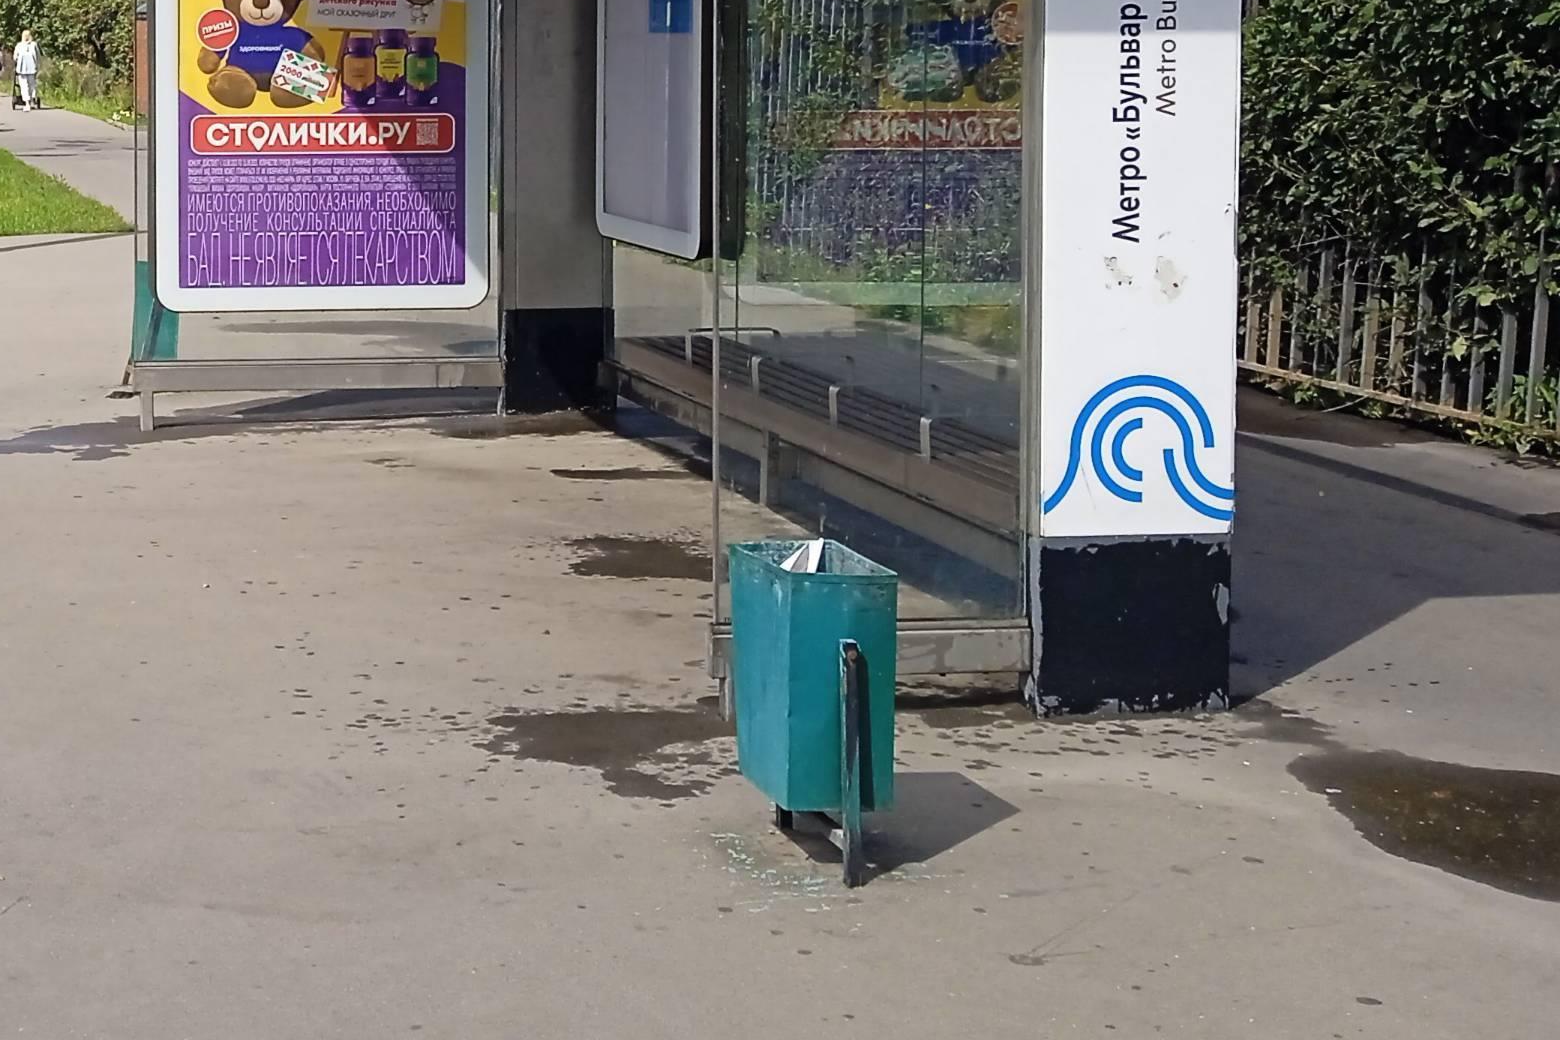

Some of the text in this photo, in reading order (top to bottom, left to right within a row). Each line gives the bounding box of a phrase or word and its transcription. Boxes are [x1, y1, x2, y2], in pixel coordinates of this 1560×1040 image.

[359, 0, 396, 7] рисунка
[202, 20, 233, 35] ПРИЗЫ
[281, 65, 302, 78] 2000
[1112, 3, 1148, 140] «Бульвар
[1155, 39, 1177, 116] Metro
[206, 121, 411, 151] СТОЛИЧКИ.РУ
[187, 191, 457, 214] ИМЕЮТСЯ ПРОТИВОПОКАЗАНИЯ. НЕОБХОДИМО
[1111, 146, 1148, 243] Метро
[187, 210, 457, 233] ПОЛУЧЕНИЕ КОНСУЛЬТАЦИИ СПЕЦИАЛИСТА
[188, 230, 457, 286] БАД. НЕ ЯВЛЯЕТСЯ ЛЕКАРСТВОМ
